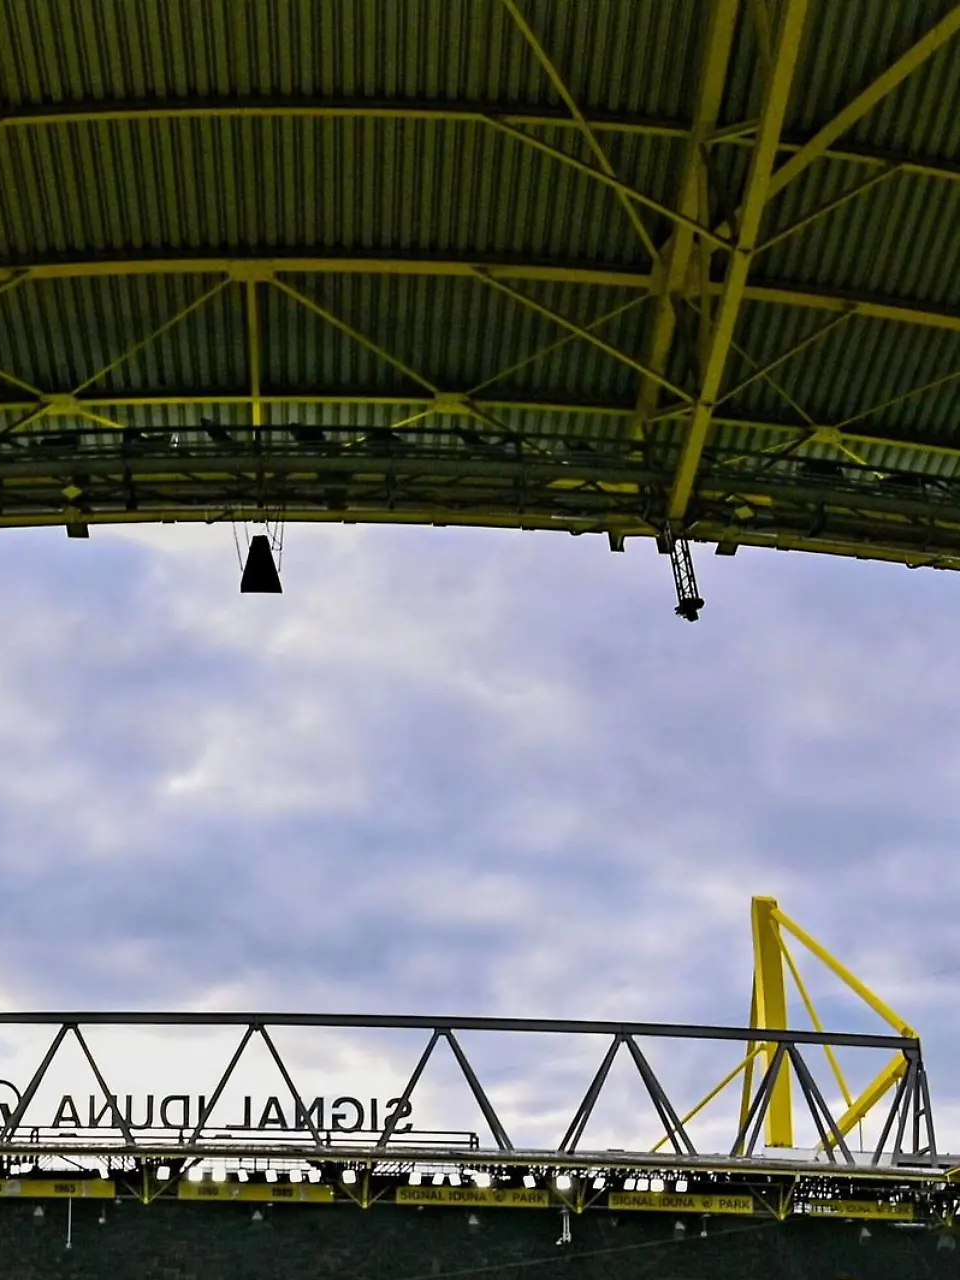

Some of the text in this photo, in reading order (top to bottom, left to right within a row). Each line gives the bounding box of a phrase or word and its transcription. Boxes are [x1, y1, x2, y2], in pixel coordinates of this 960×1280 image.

[400, 1190, 545, 1203] SIGNAL IDUNA PARK
[611, 1195, 750, 1210] SIGNAL IDUNA PARK
